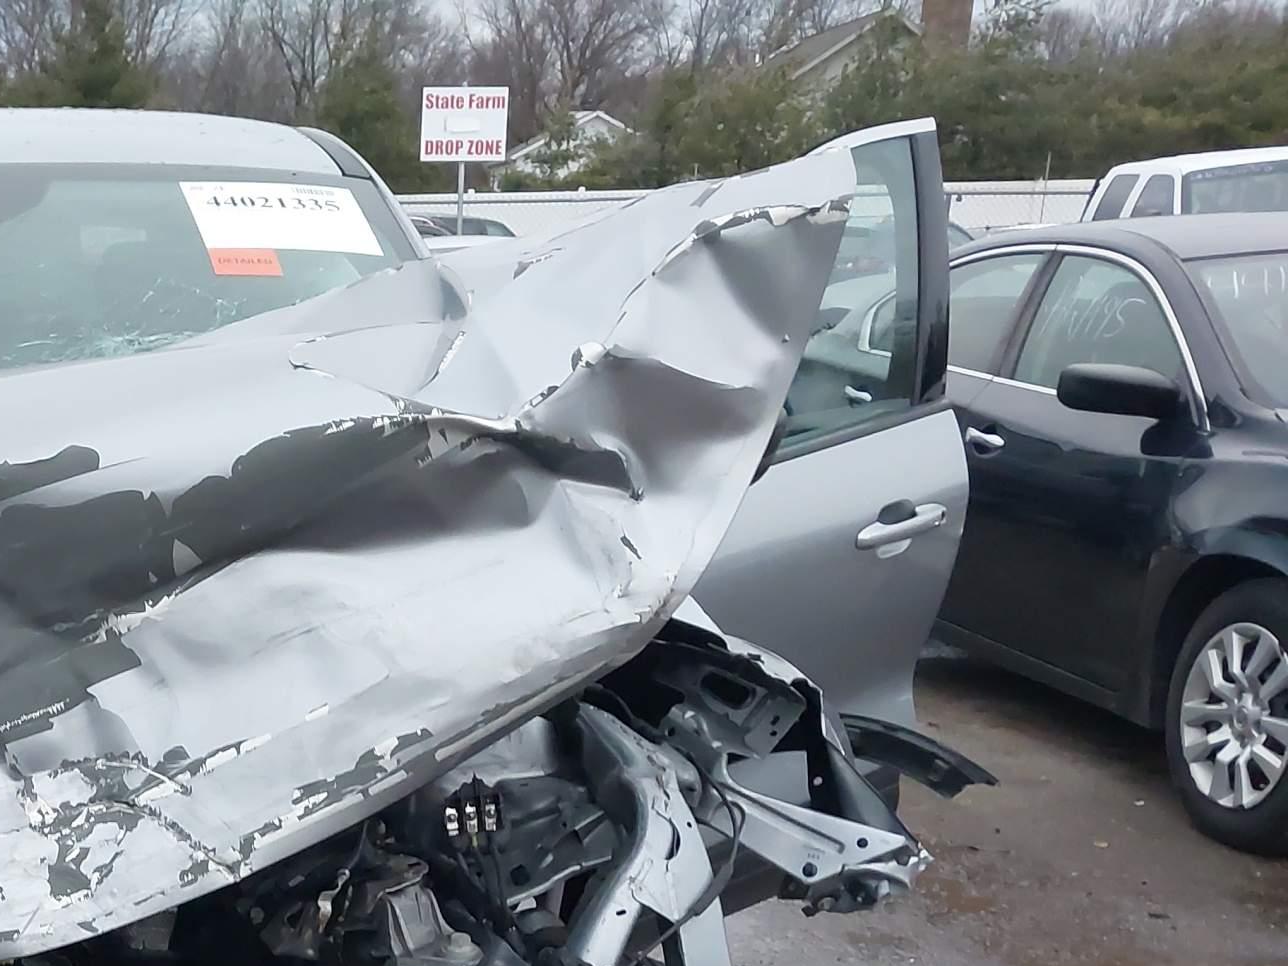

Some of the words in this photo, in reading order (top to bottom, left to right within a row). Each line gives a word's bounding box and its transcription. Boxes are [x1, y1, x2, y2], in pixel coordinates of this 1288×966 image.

[425, 93, 464, 109] State
[468, 93, 506, 109] Farm
[424, 139, 463, 156] DROP
[467, 139, 503, 156] ZONE
[205, 195, 342, 213] 44021335
